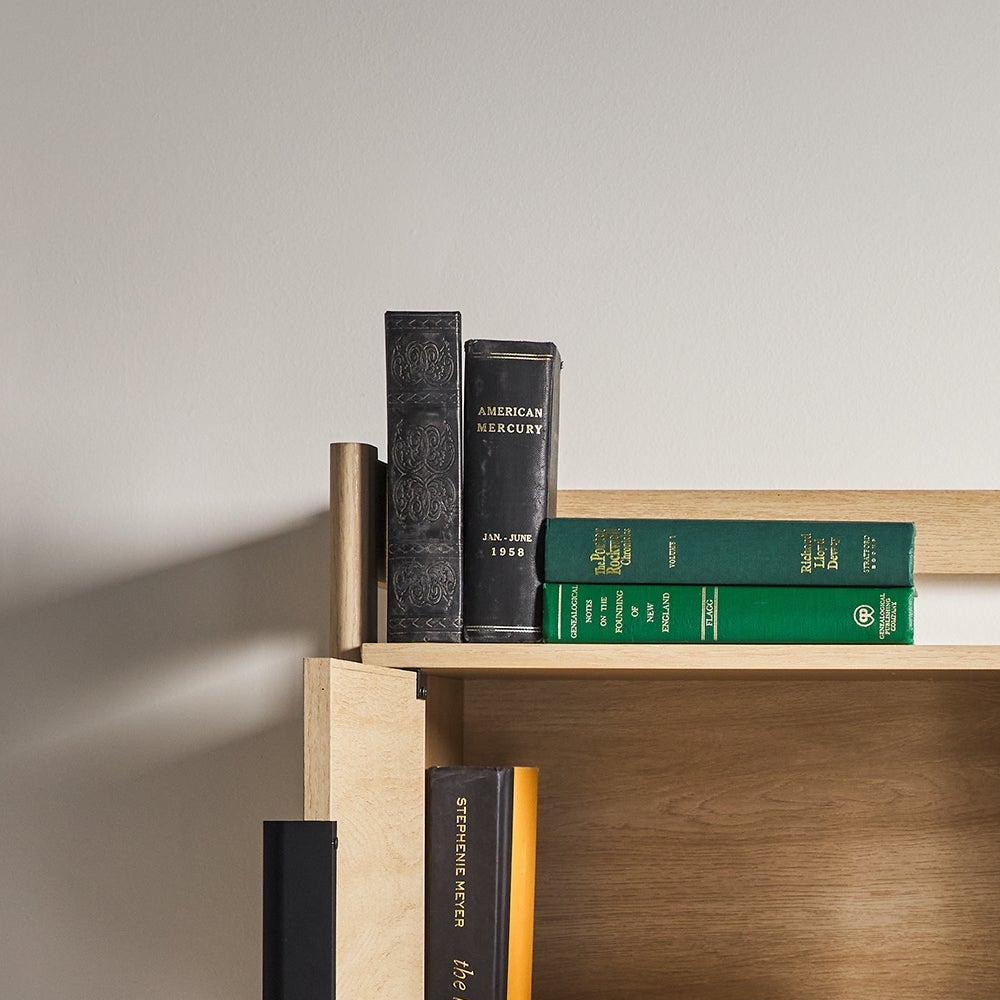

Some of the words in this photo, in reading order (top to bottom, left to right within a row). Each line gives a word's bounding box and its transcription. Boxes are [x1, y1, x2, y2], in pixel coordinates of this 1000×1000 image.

[478, 406, 543, 418] AMERICAN
[476, 423, 543, 435] MERCURY
[482, 533, 502, 542] JAN.
[508, 534, 533, 543] JUNE
[491, 547, 525, 557] 1958
[669, 541, 677, 568] VOLUME
[800, 533, 812, 573] Richard
[814, 538, 827, 568] Lloyd
[827, 537, 840, 570] Dewey
[570, 585, 579, 639] GENEALOGICAL
[585, 599, 593, 623] NOTES
[600, 615, 607, 627] ON
[615, 590, 624, 634] FOUNDING
[631, 606, 639, 618] OF
[646, 602, 654, 623] NEW
[661, 592, 670, 633] ENGLAND
[705, 599, 714, 627] FLAGG
[455, 797, 467, 876] STEPHENIE
[454, 880, 466, 928] MEYER
[453, 959, 475, 991] the
